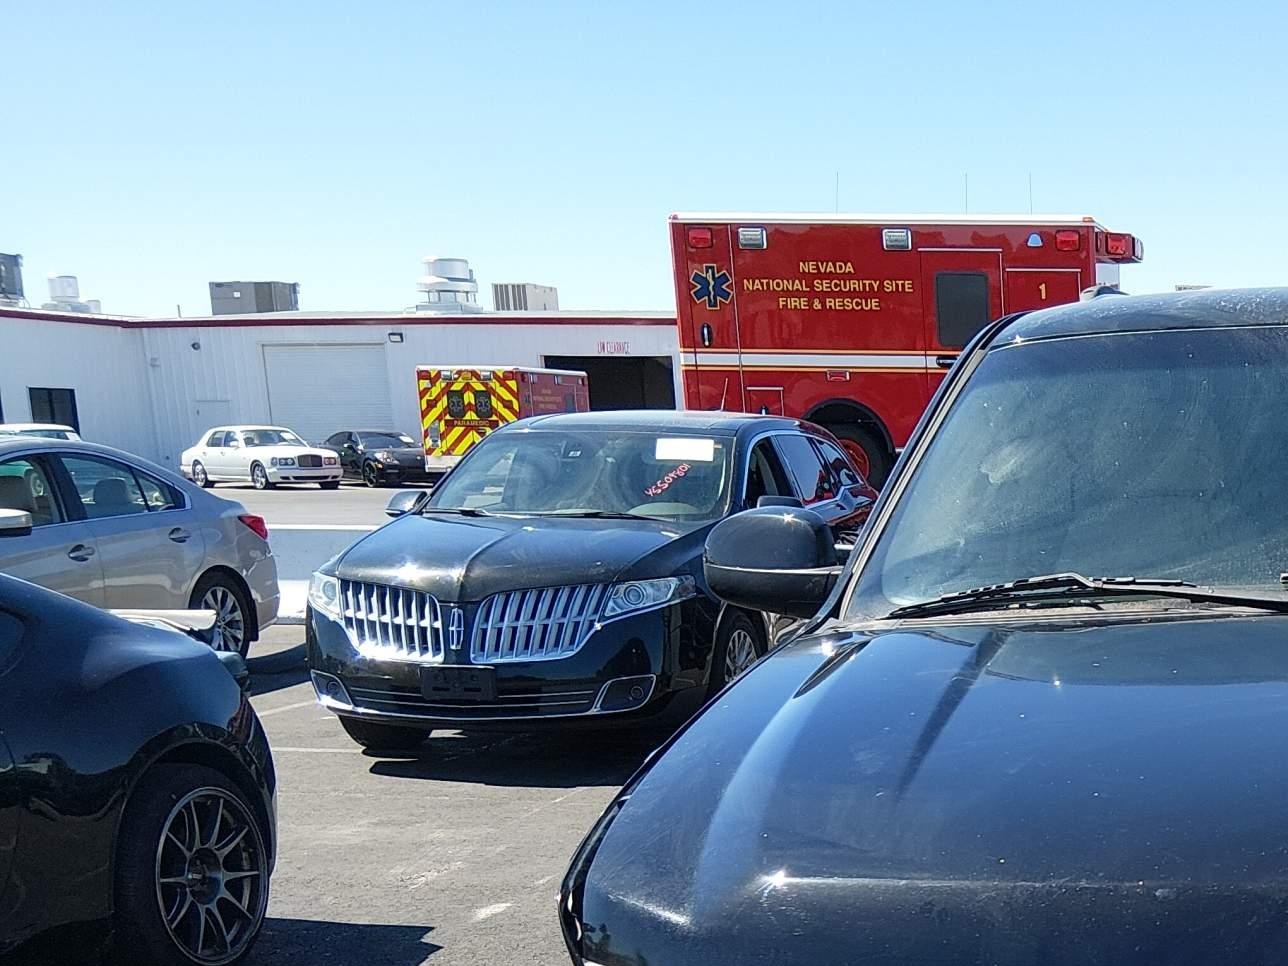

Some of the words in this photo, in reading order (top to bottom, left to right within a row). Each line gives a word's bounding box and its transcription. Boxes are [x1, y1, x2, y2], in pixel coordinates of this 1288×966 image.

[799, 261, 855, 274] NEVADA
[743, 279, 810, 291] NATIONAL
[813, 279, 880, 292] SECURITY
[883, 280, 914, 292] SITE
[1038, 283, 1047, 300] 1
[778, 297, 809, 310] FIRE
[812, 298, 822, 310] &
[825, 298, 881, 311] RESCUE
